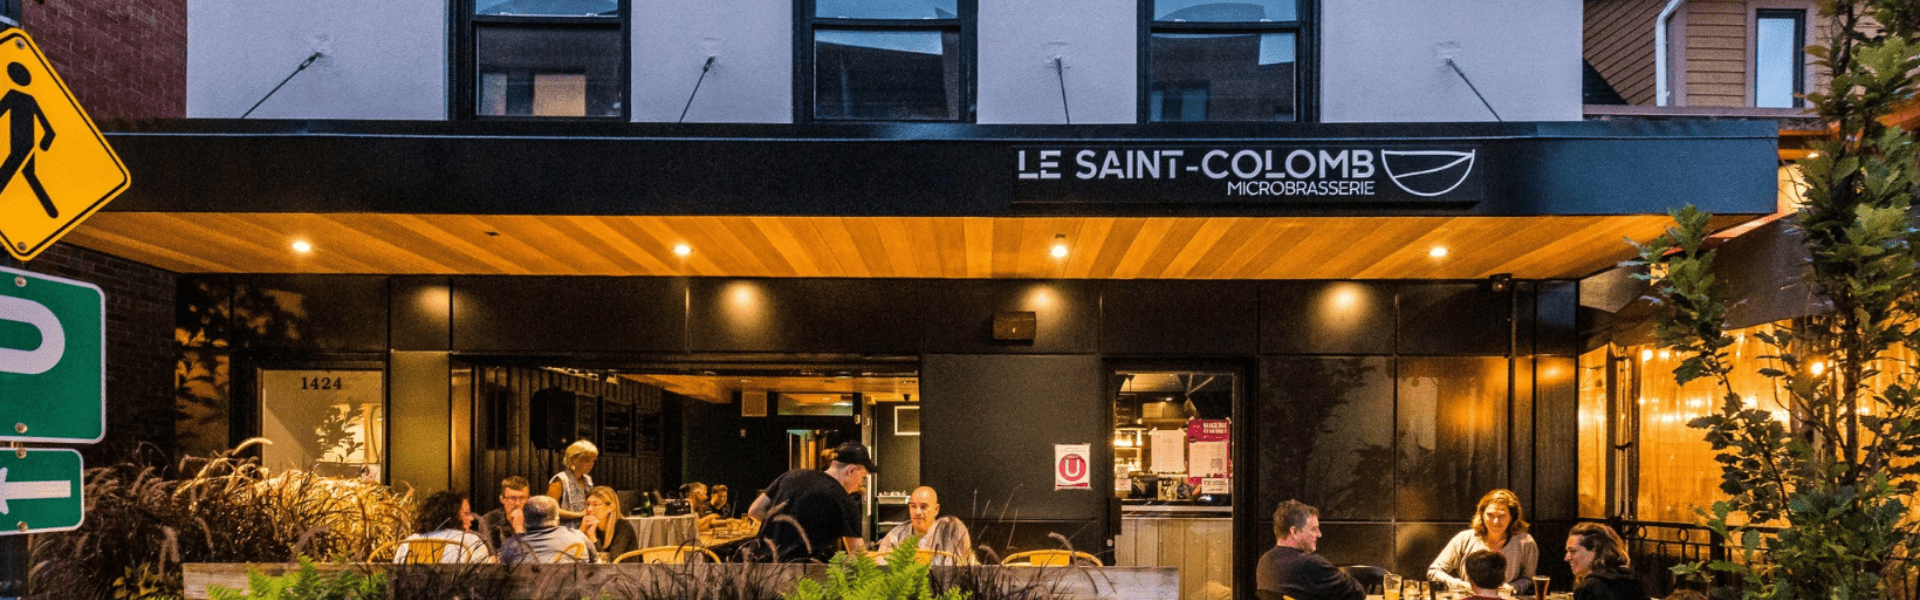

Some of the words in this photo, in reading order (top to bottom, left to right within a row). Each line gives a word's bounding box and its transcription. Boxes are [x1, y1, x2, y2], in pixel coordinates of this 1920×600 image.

[1018, 150, 1061, 179] LE
[1075, 149, 1375, 179] SAINT-COLOMB
[1227, 181, 1375, 196] MICROBRASSERIE
[301, 376, 342, 390] 1424
